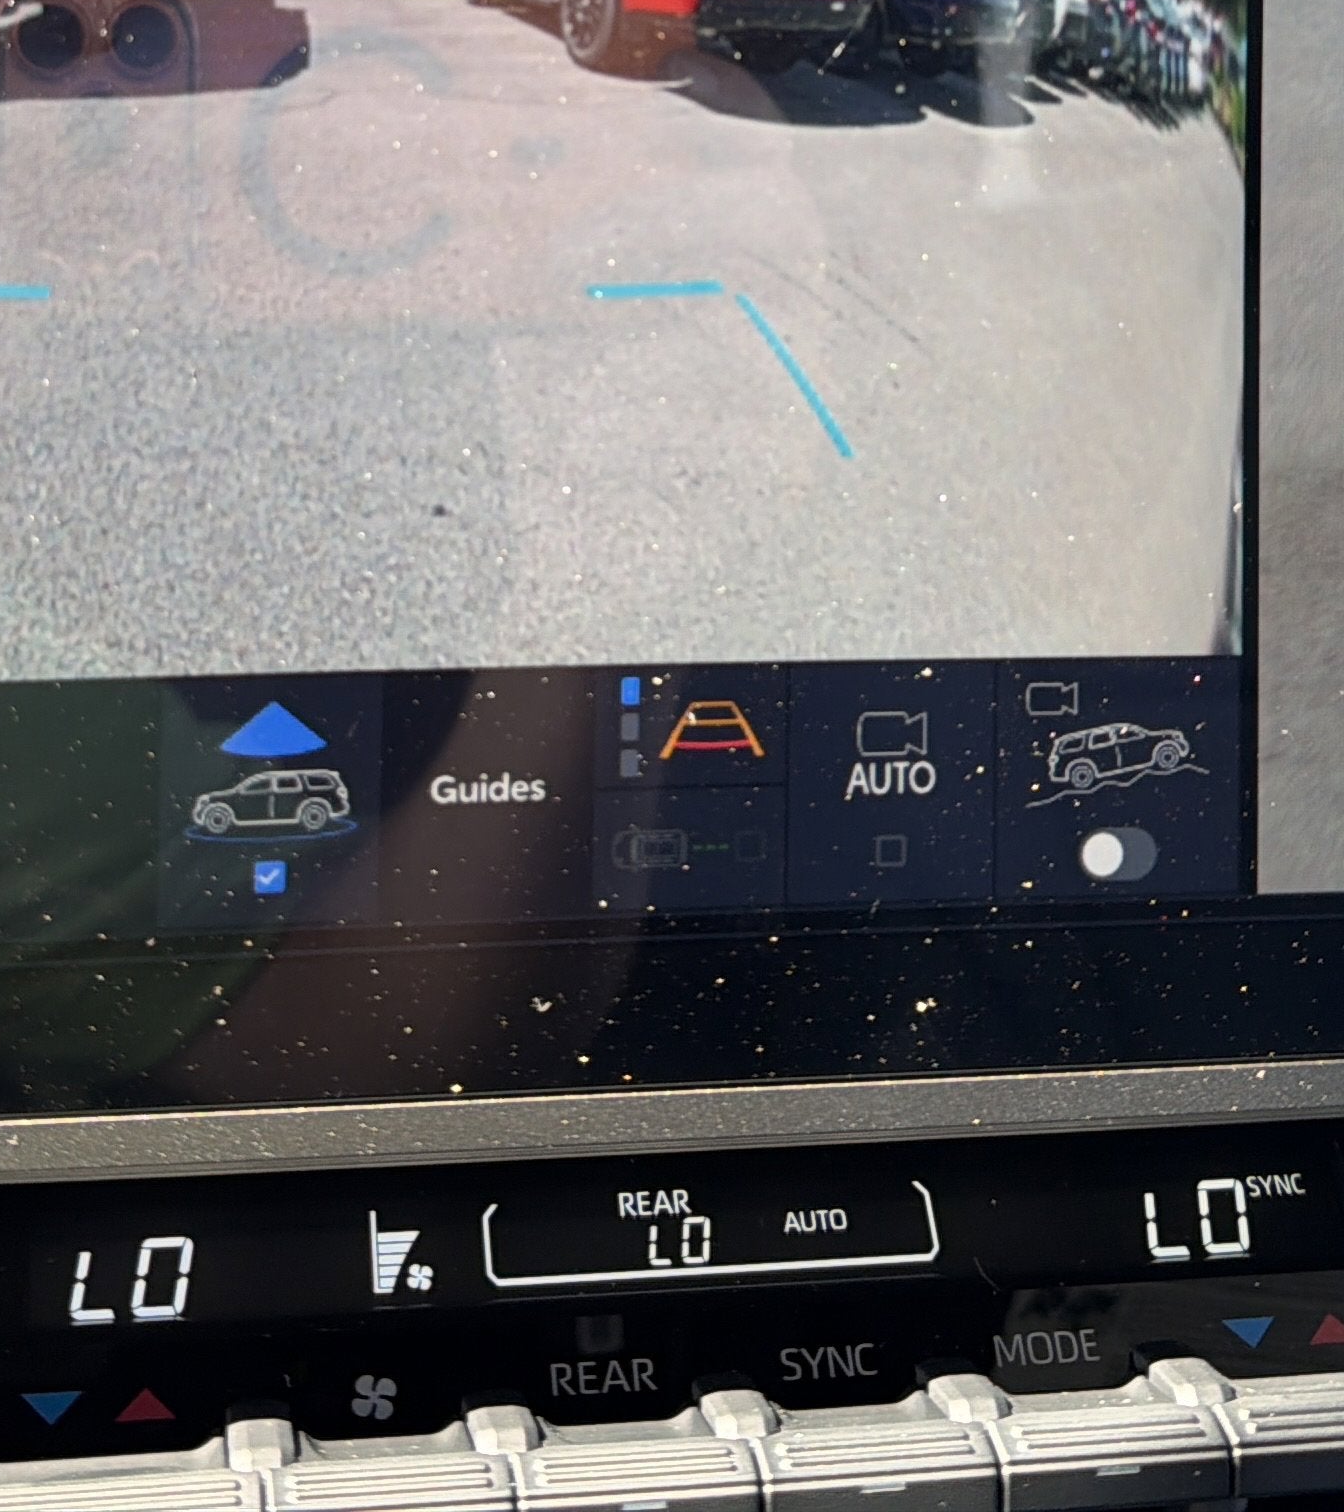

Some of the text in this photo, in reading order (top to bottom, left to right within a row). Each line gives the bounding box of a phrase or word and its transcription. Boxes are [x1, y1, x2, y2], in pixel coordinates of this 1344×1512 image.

[429, 773, 548, 807] Guides
[845, 759, 938, 796] AUTO
[1246, 1173, 1307, 1198] SYNC
[617, 1189, 691, 1218] REAR
[783, 1208, 849, 1233] AUTO
[780, 1343, 878, 1383] SYNC
[992, 1328, 1101, 1368] MODE
[550, 1357, 658, 1398] REAR
